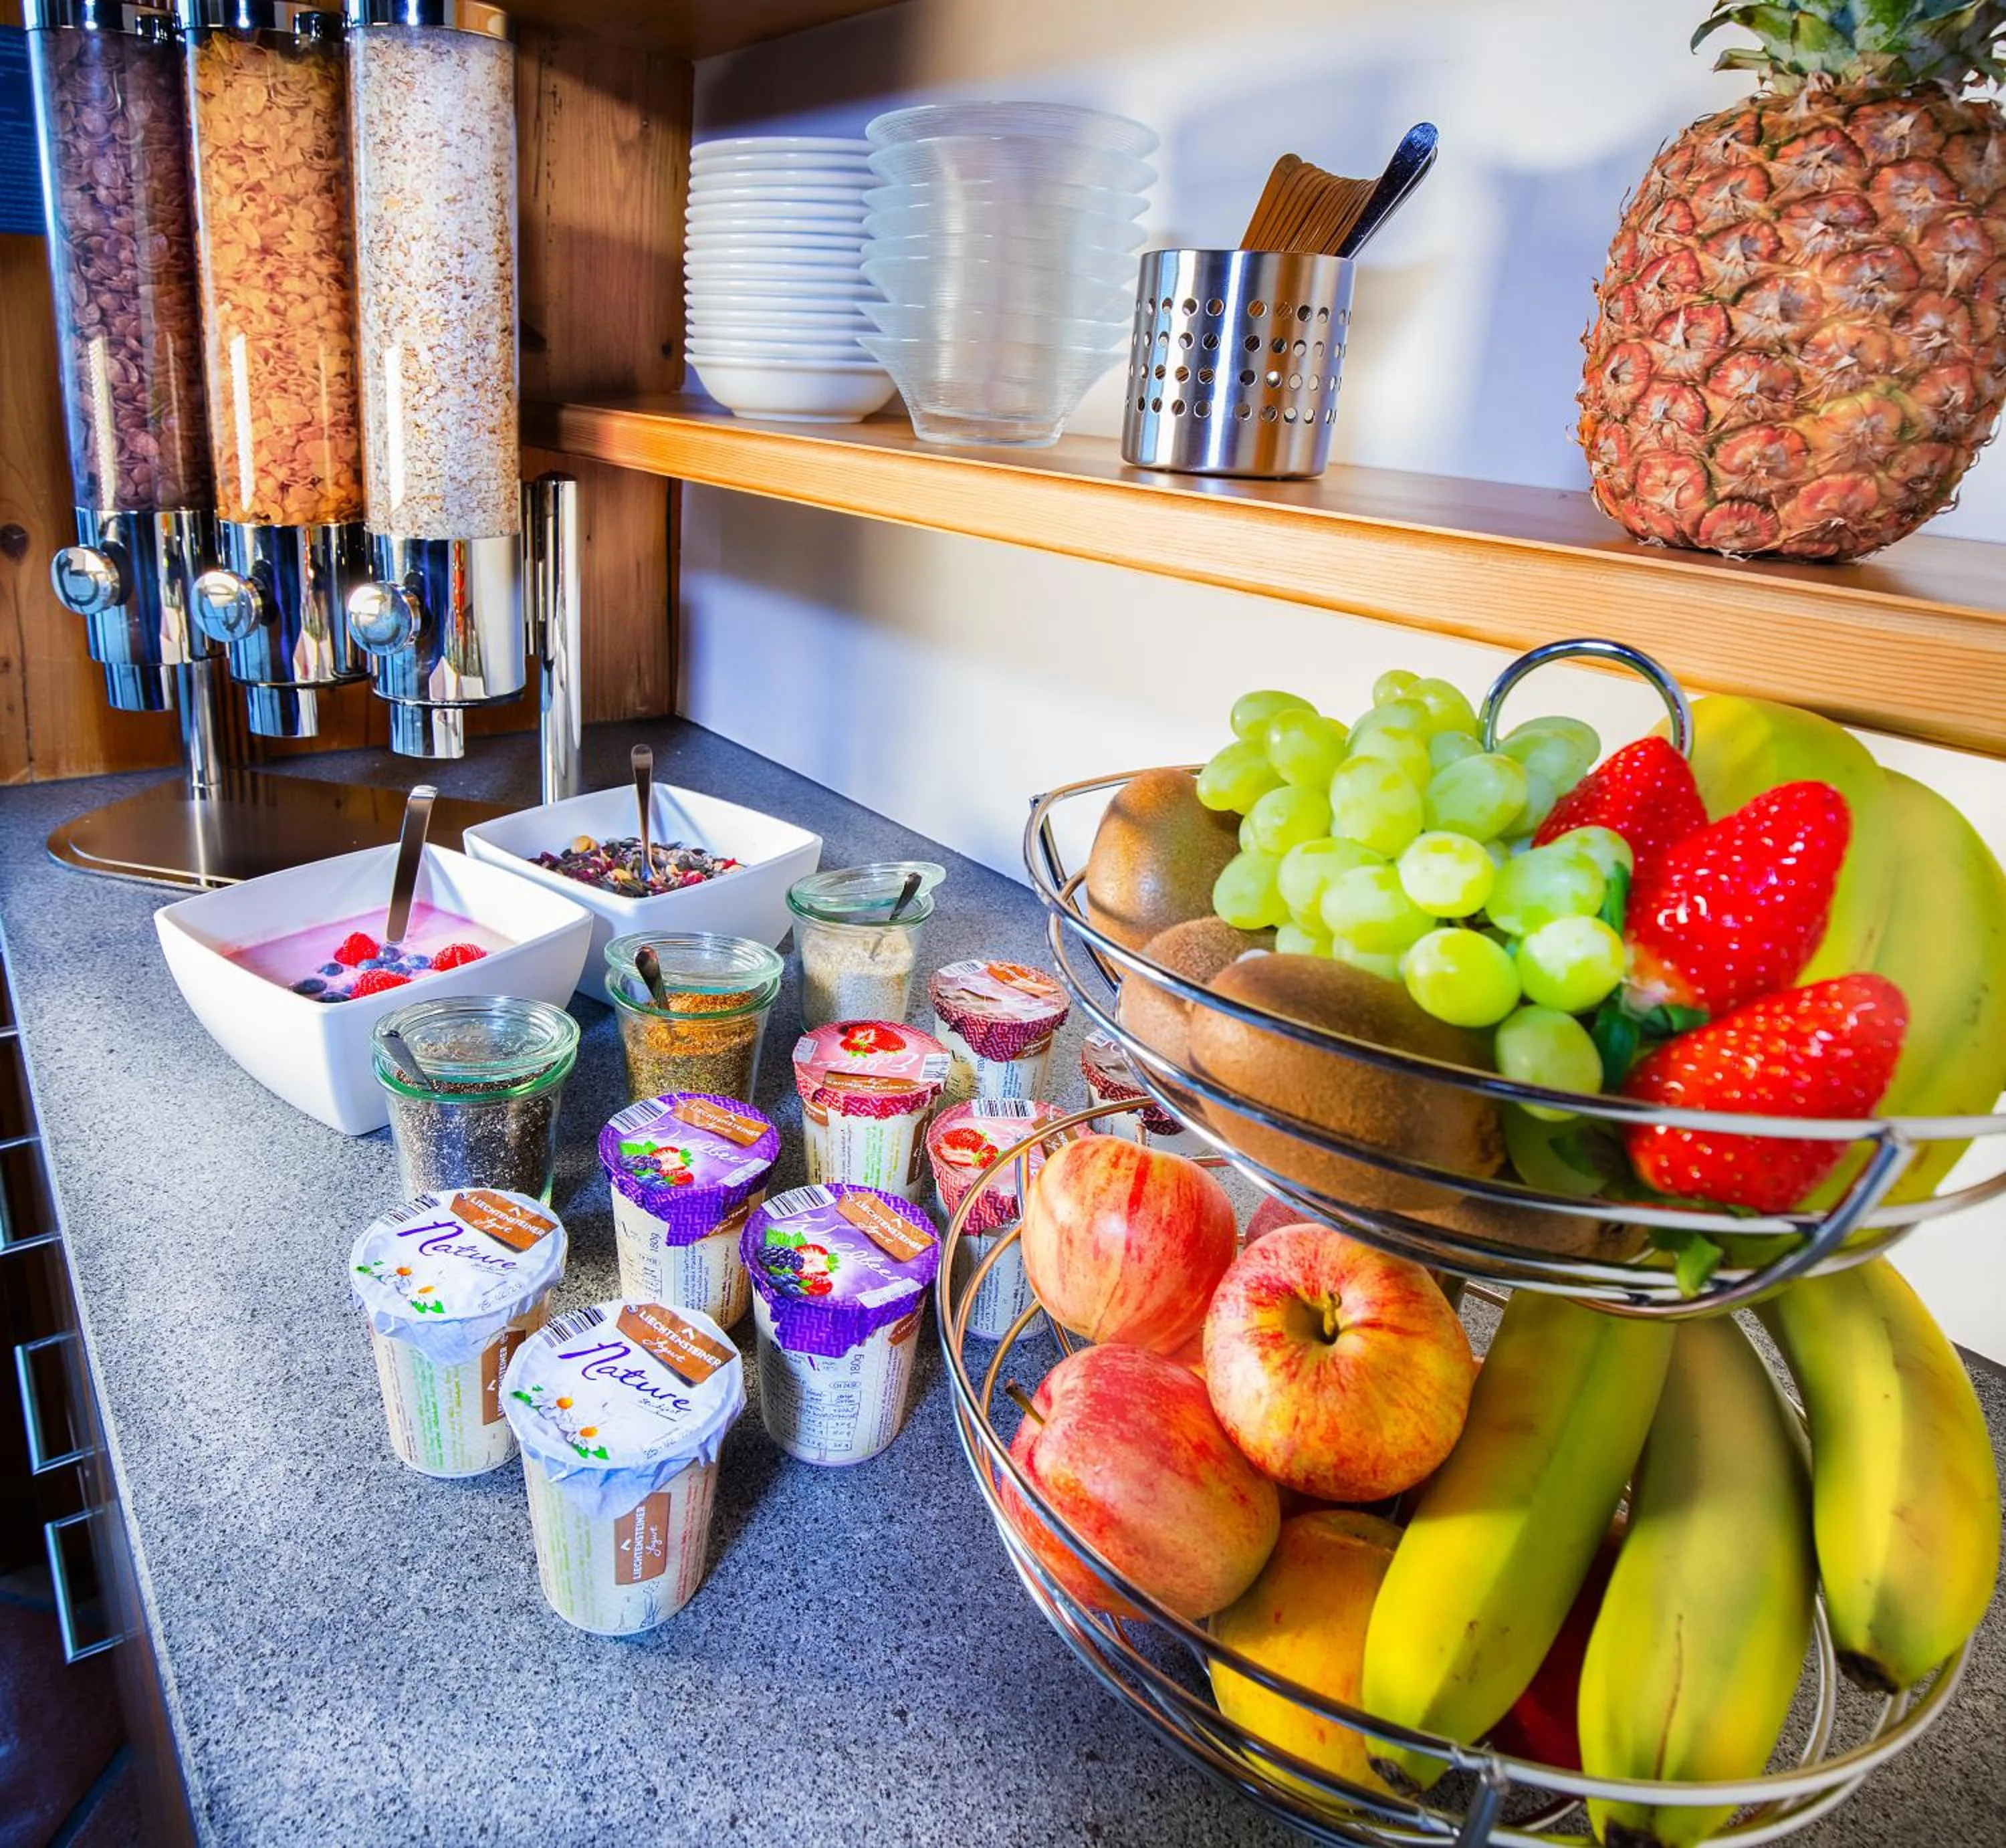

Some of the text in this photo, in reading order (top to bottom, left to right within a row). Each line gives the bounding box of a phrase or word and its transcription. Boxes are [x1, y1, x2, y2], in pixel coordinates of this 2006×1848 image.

[469, 1195, 547, 1237] LIECHTENSTEINER
[855, 1200, 925, 1252] LIECHTENSTEINER
[397, 1220, 520, 1270] Nature
[638, 1309, 723, 1369] LIECHTENSTEINER
[557, 1340, 693, 1412] Nature
[632, 1505, 646, 1582] LIECHTENSTEINER
